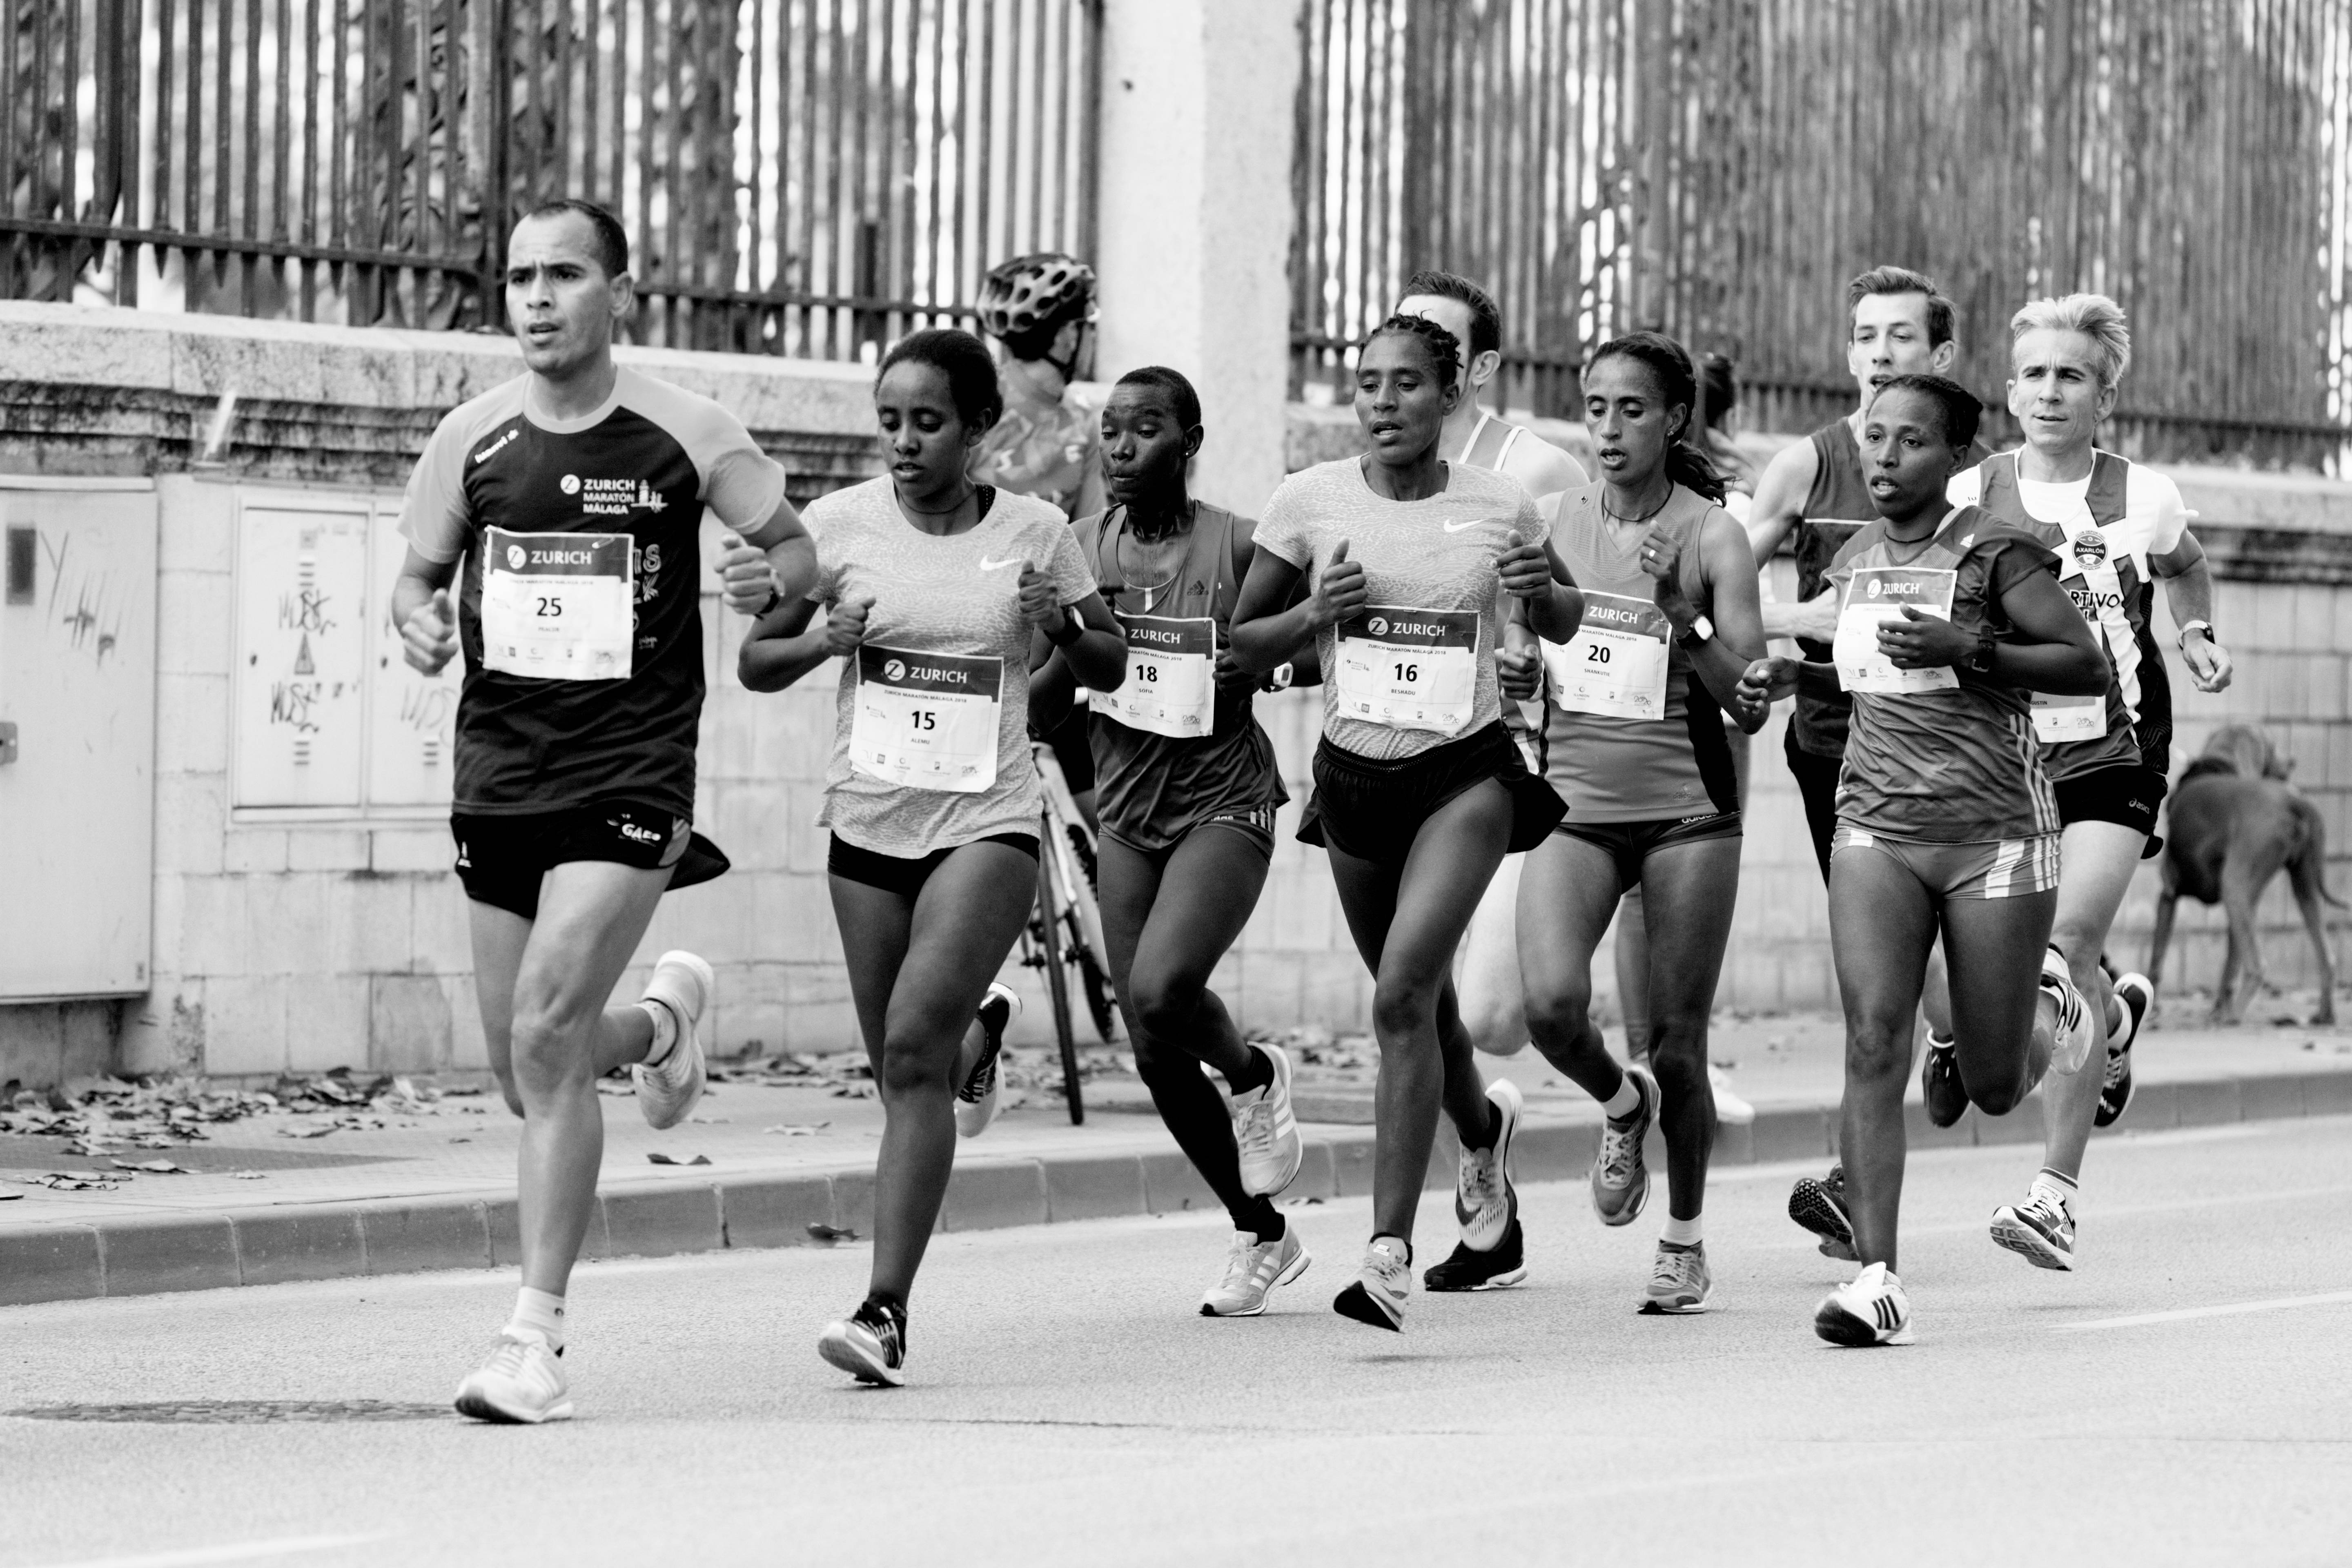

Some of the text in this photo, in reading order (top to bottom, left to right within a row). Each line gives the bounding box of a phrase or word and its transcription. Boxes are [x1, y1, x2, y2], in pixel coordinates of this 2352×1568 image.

[584, 479, 635, 491] ZURICH
[584, 492, 635, 503] MARATÓN
[583, 503, 628, 514] MÁLAGA
[531, 550, 592, 565] ZURICH
[1882, 582, 1920, 594] ZURICH
[2069, 589, 2120, 608] RTIVO
[537, 597, 562, 617] 25
[1588, 606, 1639, 624] ZURICH
[1130, 629, 1180, 644] ZURICH
[1392, 623, 1446, 636] ZURICH
[1588, 645, 1610, 664] 20
[910, 666, 967, 684] ZURICH
[1136, 665, 1158, 682] 18
[1394, 663, 1418, 682] 16
[1584, 668, 1610, 677] SHANKUTIE
[911, 710, 935, 730] 15
[2135, 801, 2150, 815] asics
